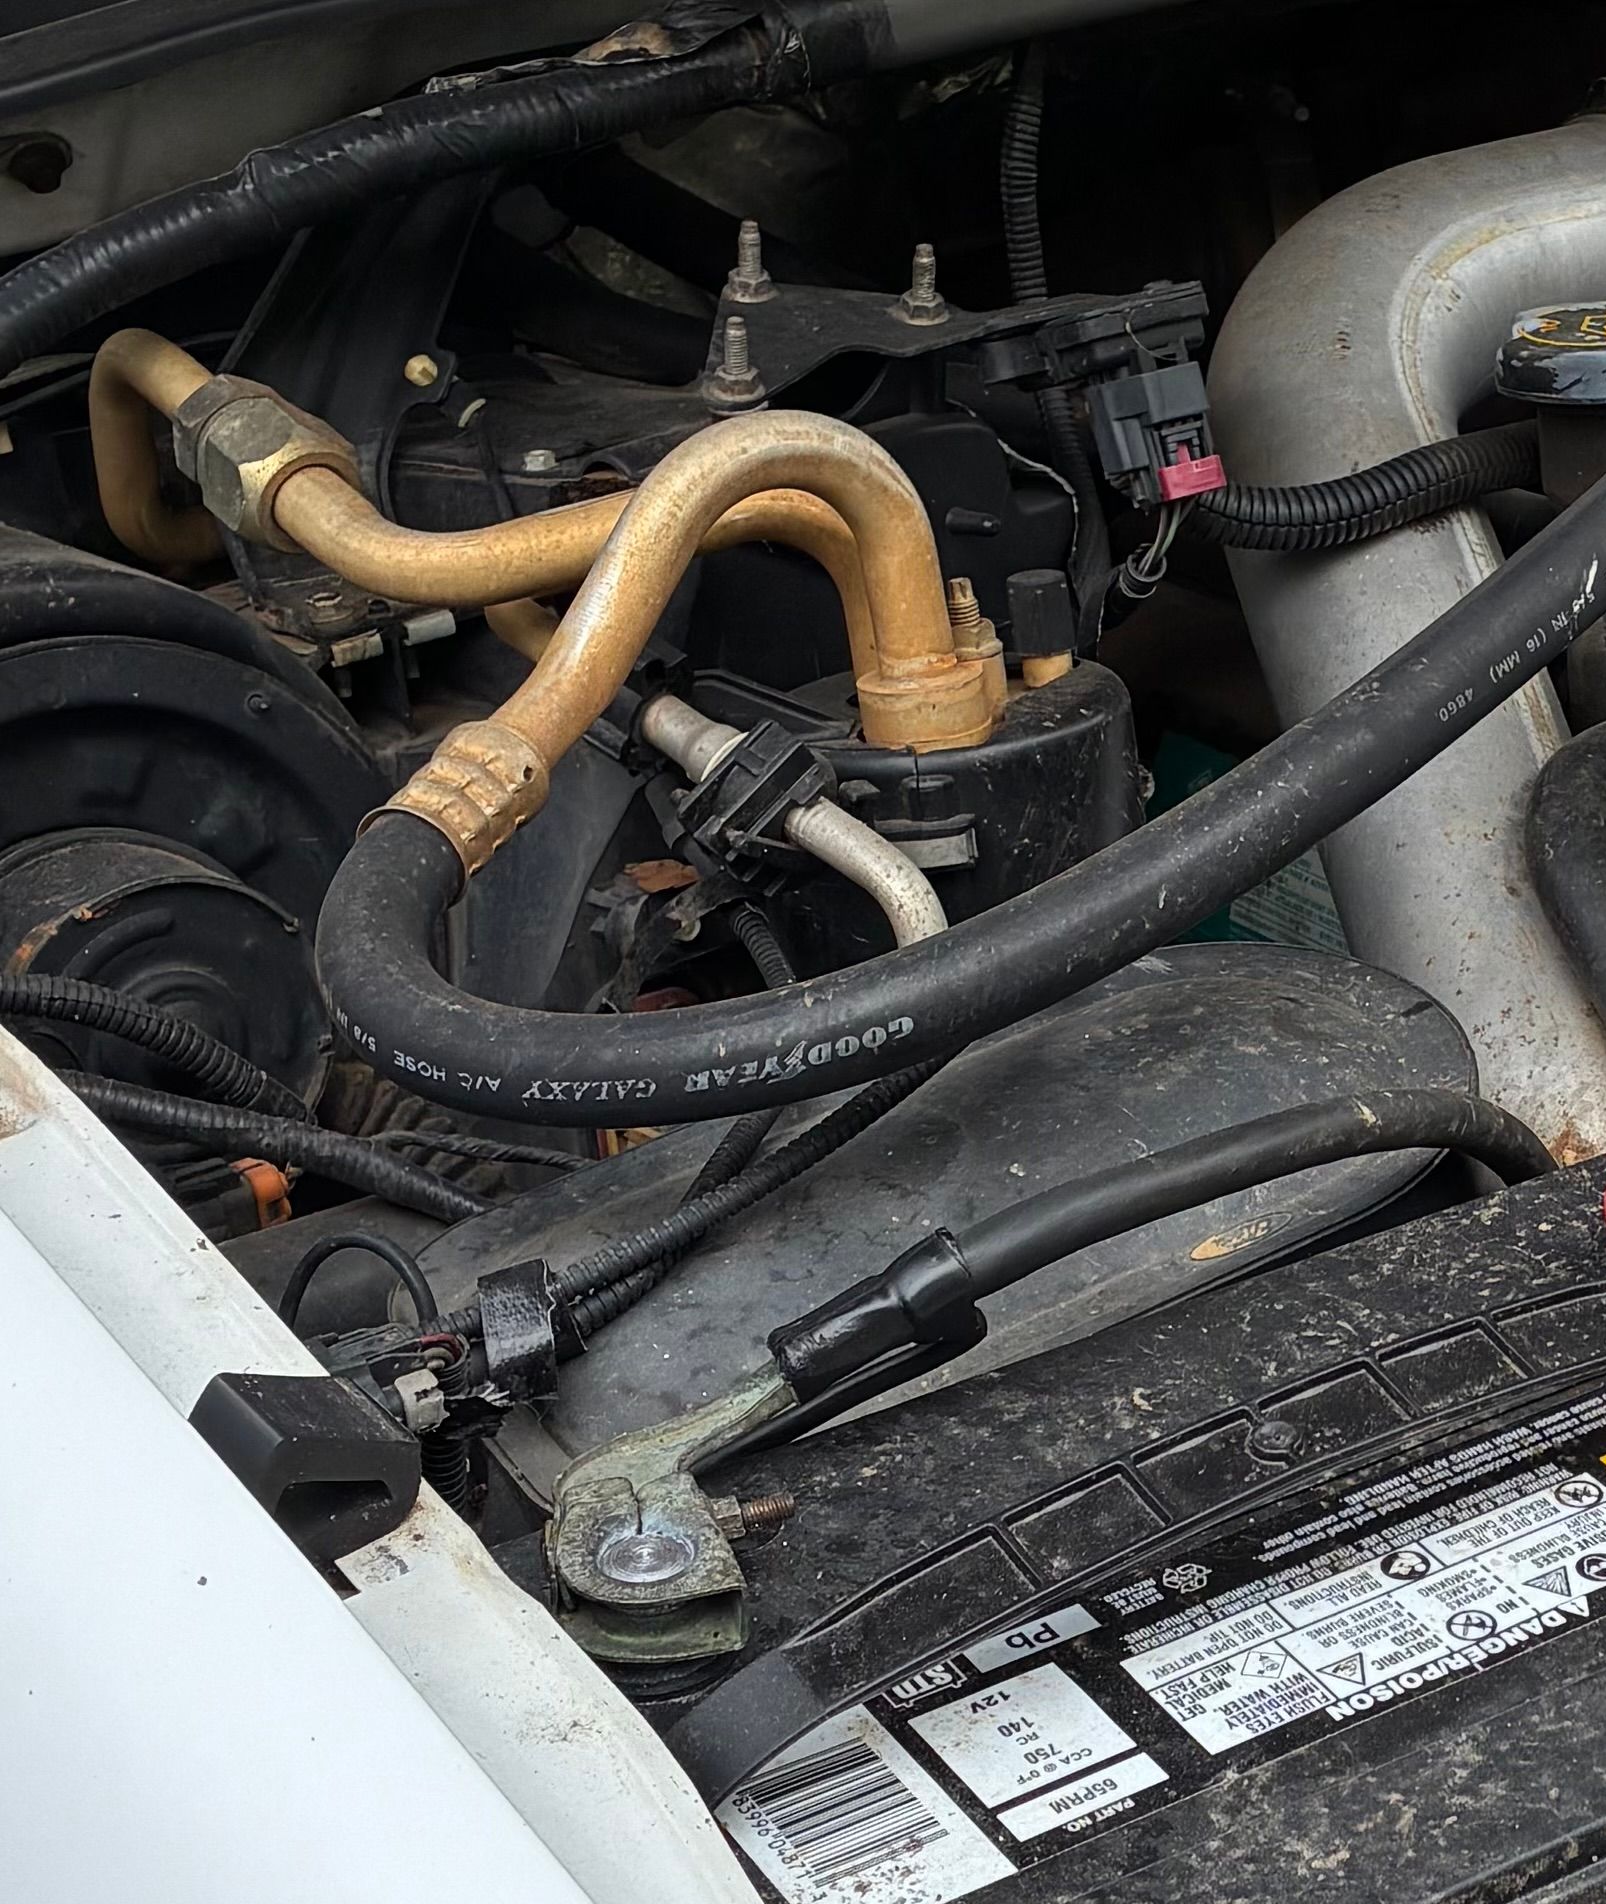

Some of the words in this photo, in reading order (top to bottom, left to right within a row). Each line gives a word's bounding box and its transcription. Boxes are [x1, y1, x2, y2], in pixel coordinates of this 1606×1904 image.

[1525, 627, 1547, 654] (16
[1488, 650, 1521, 684] MM)
[354, 1025, 376, 1052] 5/8
[684, 1016, 914, 1092] GOODYEAR
[394, 1049, 446, 1081] HOSE
[458, 1072, 502, 1093] A/C
[521, 1077, 658, 1104] GALAXY
[1534, 1462, 1558, 1477] NOT
[1456, 1472, 1535, 1508] RECOMMENDED
[1491, 1490, 1519, 1505] RISK
[1432, 1503, 1457, 1517] FOR
[1479, 1500, 1494, 1511] OF
[1511, 1497, 1550, 1517] REACH
[1533, 1506, 1560, 1521] KEEP
[1381, 1513, 1434, 1538] INVERTED
[1498, 1512, 1513, 1524] OF
[1507, 1517, 1532, 1531] OUT
[1570, 1518, 1606, 1537] CAUSE
[1389, 1518, 1449, 1546] EXPLOSION
[1436, 1520, 1496, 1545] CHILDREN.
[1467, 1534, 1491, 1547] THE
[1492, 1527, 1508, 1538] OF
[1309, 1545, 1357, 1568] FOLLOW
[1372, 1542, 1391, 1554] OR
[1508, 1533, 1570, 1562] BLINDNESS
[1531, 1545, 1574, 1568] GASES
[1264, 1563, 1310, 1585] PROPER
[1289, 1574, 1313, 1588] NOT
[1312, 1567, 1332, 1578] DO
[1128, 1587, 1156, 1602] MUST
[1206, 1580, 1268, 1608] CHARGING
[1284, 1571, 1372, 1609] INSTRUCTIONS.
[1349, 1579, 1382, 1596] READ
[1111, 1598, 1126, 1608] BE
[1117, 1593, 1163, 1615] BATTERY
[1212, 1583, 1289, 1618] DISASSEMBLE
[1325, 1592, 1349, 1605] ALL
[1496, 1599, 1518, 1613] NO
[1193, 1614, 1212, 1626] OR
[1253, 1610, 1273, 1623] DO
[1349, 1600, 1393, 1622] SEVERE
[1120, 1604, 1207, 1643] INSTRUCTIONS.
[1228, 1618, 1254, 1633] NOT
[1263, 1620, 1283, 1632] DO
[1302, 1617, 1348, 1639] BURNS.
[1338, 1609, 1403, 1639] BLINDNESS
[1388, 1618, 1413, 1632] CAN
[1005, 1623, 1059, 1648] Pb
[1203, 1629, 1229, 1642] TIP.
[1238, 1627, 1263, 1642] NOT
[1318, 1636, 1338, 1647] OR
[1348, 1629, 1388, 1648] CAUSE
[1390, 1627, 1424, 1646] ACID
[1203, 1638, 1238, 1656] OPEN
[1371, 1638, 1438, 1670] SULFURIC
[1147, 1651, 1204, 1679] BATTERY.
[1200, 1662, 1235, 1682] HELP
[1327, 1611, 1564, 1719] DANGER/POISON
[1155, 1678, 1197, 1699] FAST.
[1268, 1672, 1308, 1693] WITH
[970, 1691, 1010, 1713] 12V
[1165, 1678, 1230, 1709] MEDICAL
[1213, 1689, 1270, 1715] WATER.
[1283, 1691, 1330, 1717] FLUSH
[1177, 1703, 1206, 1721] GET
[1225, 1682, 1318, 1728] IMMEDIATELY
[997, 1717, 1033, 1736] 140
[1245, 1711, 1284, 1733] EYES
[1015, 1731, 1039, 1745] RC
[1023, 1743, 1061, 1763] 750
[1058, 1748, 1092, 1764] CCA
[1049, 1778, 1117, 1813] 65PRM
[1094, 1798, 1134, 1820] PART
[1062, 1816, 1092, 1831] NO.
[767, 1839, 811, 1878] 04871
